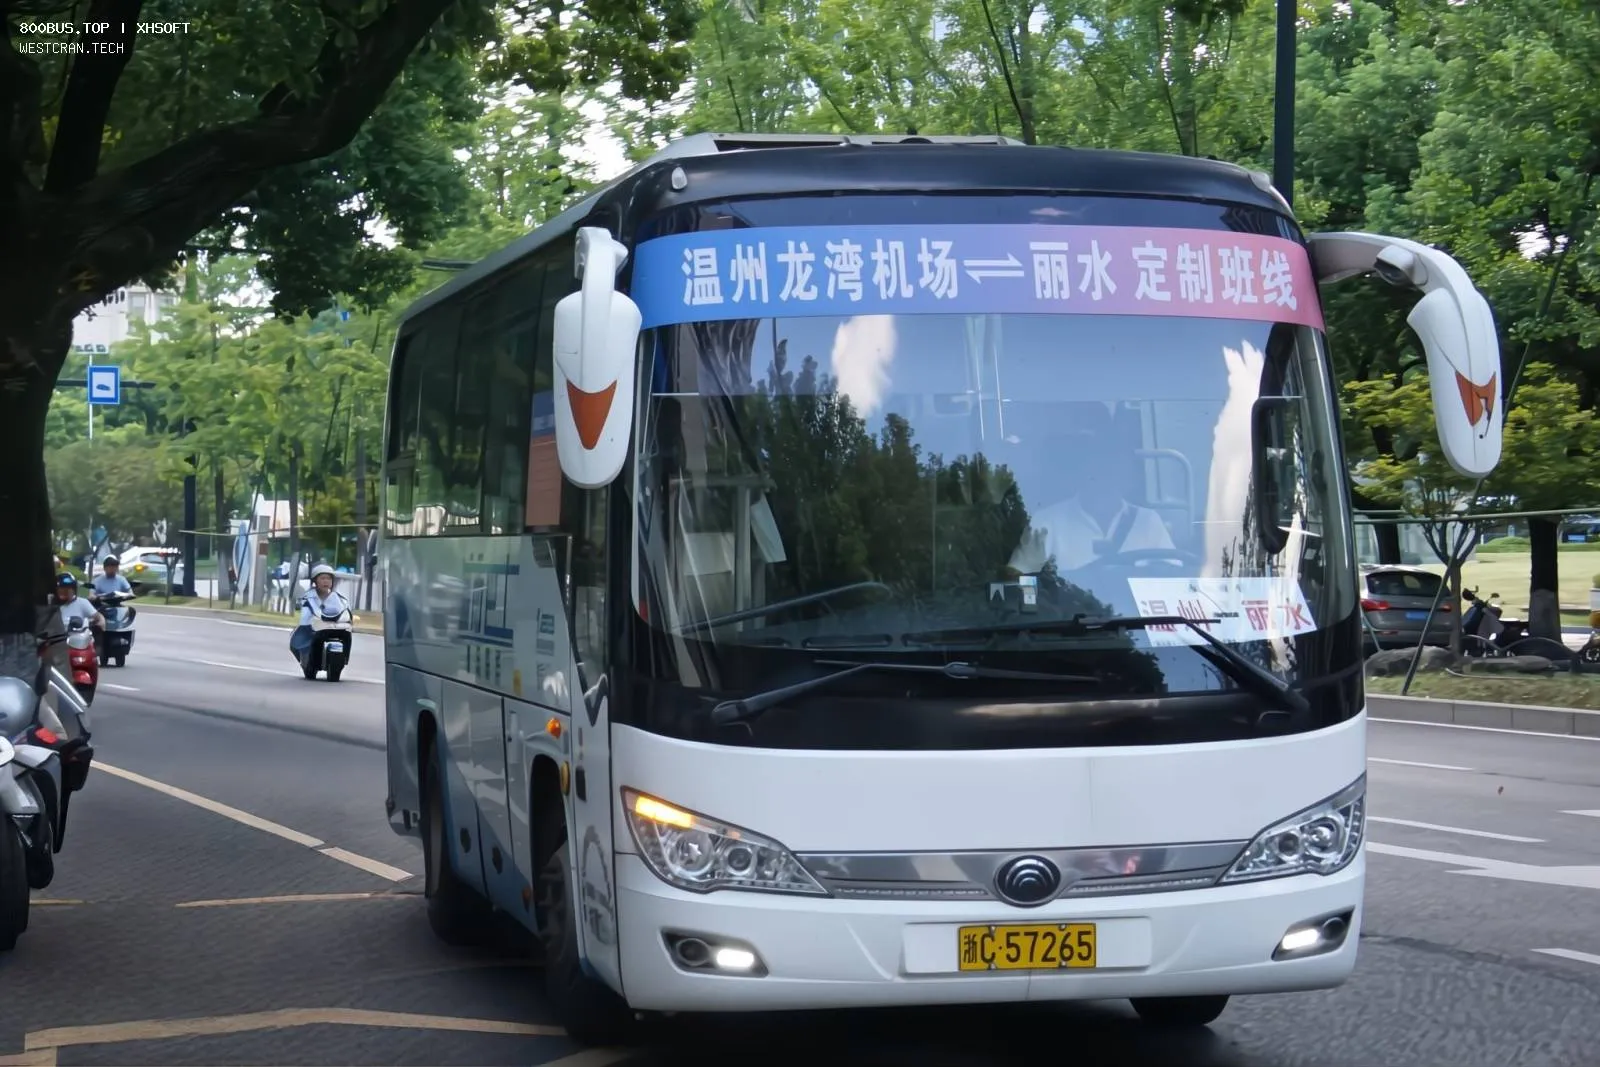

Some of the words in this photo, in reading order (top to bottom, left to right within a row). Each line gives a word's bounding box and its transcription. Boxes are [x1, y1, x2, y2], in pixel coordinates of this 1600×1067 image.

[681, 238, 959, 306] 温州龙湾机场
[1029, 239, 1118, 301] 丽水
[1131, 240, 1297, 310] 定制班线
